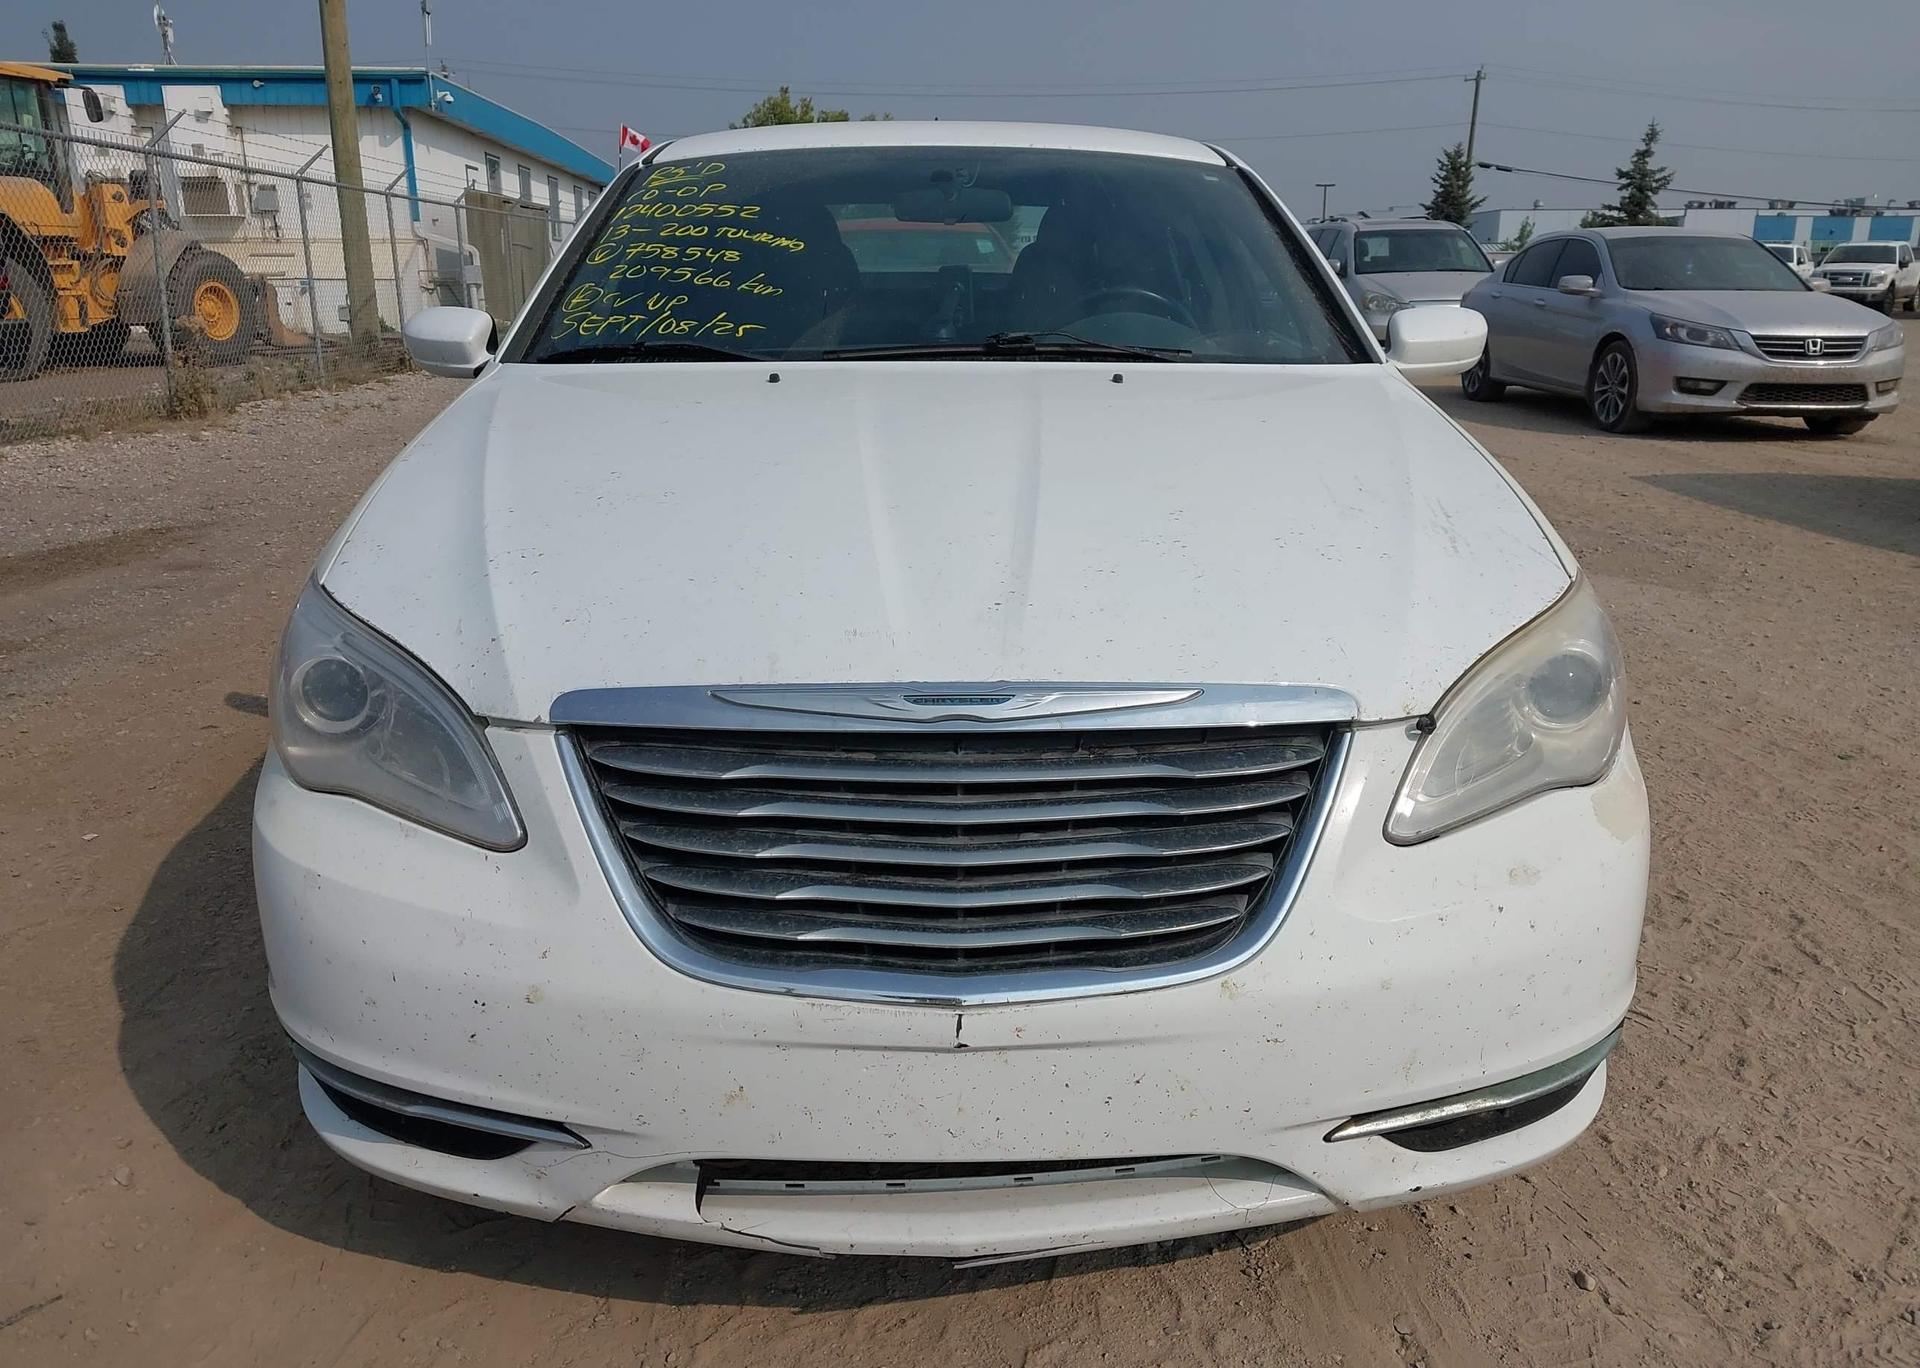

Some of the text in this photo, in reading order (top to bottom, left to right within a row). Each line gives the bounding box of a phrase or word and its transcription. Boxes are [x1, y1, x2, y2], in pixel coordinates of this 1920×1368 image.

[611, 203, 761, 224] 12400552
[660, 223, 709, 236] 200
[626, 242, 744, 263] 758548
[609, 264, 732, 288] 209566
